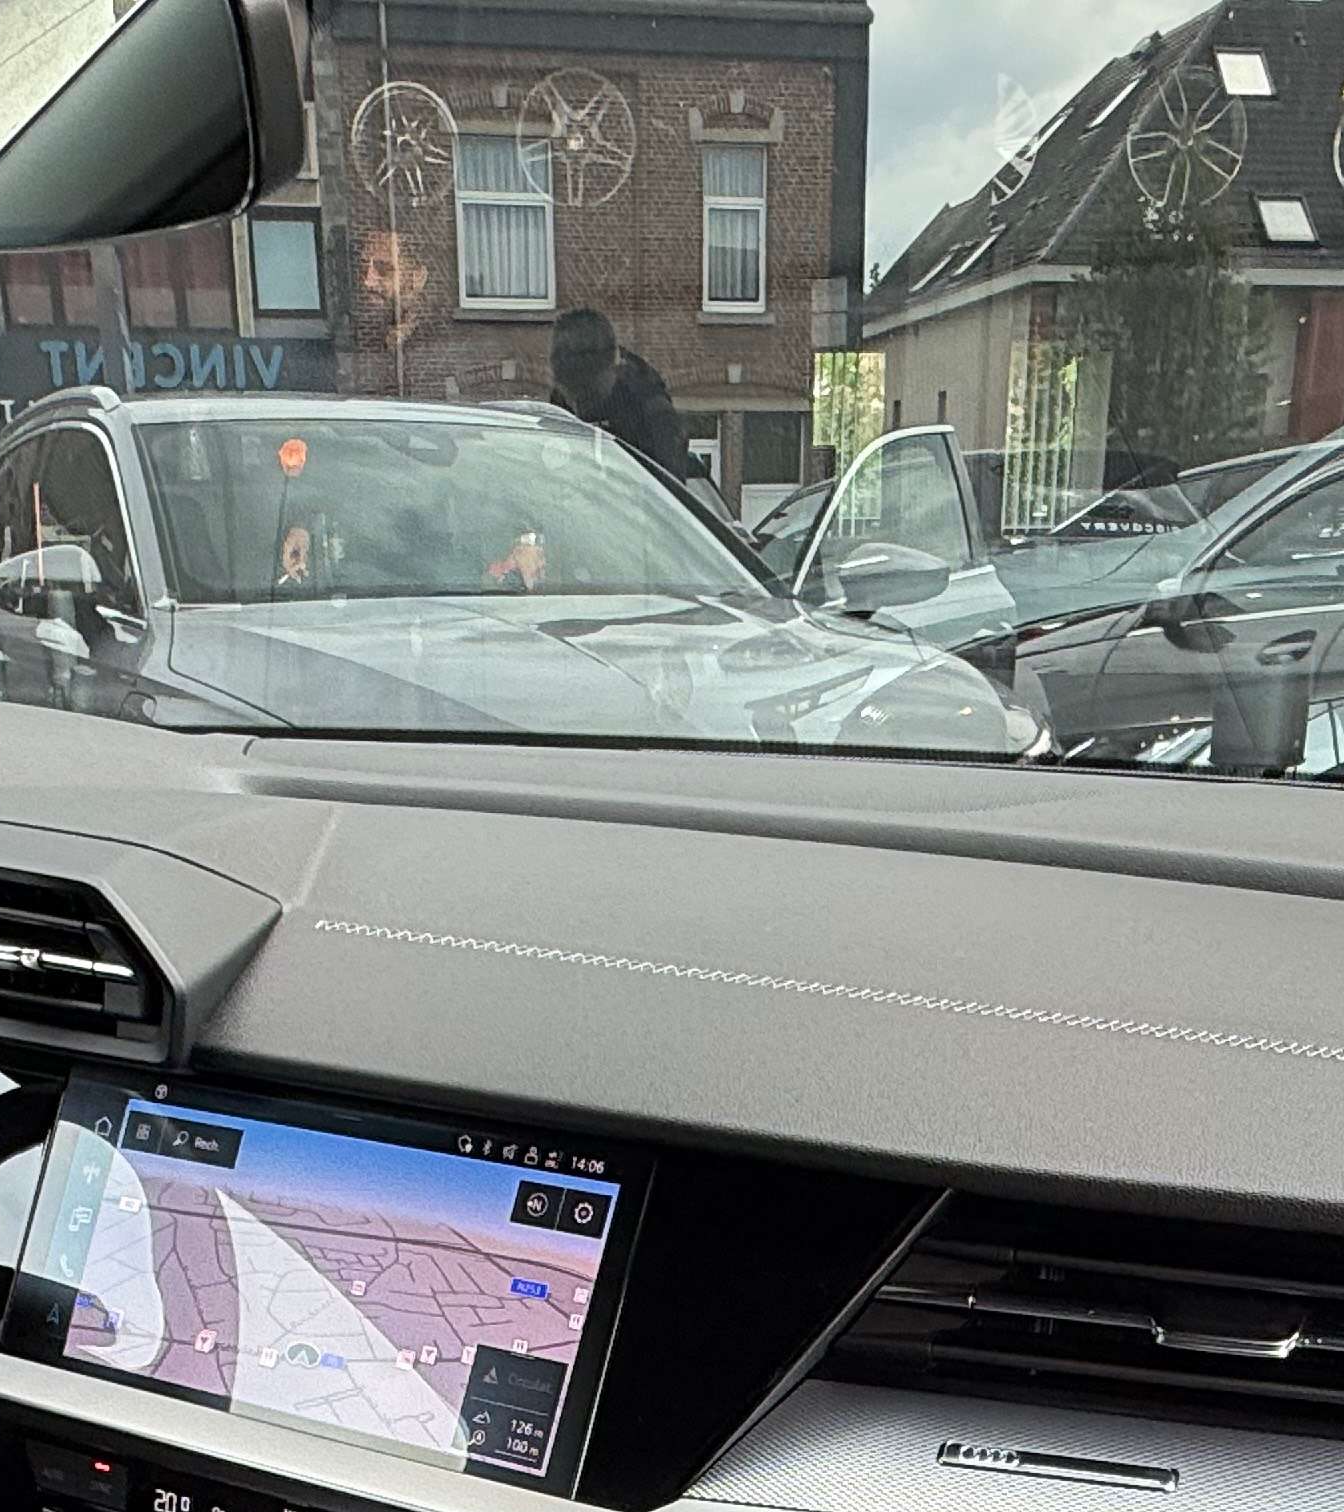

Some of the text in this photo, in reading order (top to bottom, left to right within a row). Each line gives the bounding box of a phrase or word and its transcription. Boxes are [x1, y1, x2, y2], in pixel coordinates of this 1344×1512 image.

[572, 1156, 605, 1174] 14:06
[510, 1418, 533, 1436] 126
[506, 1436, 528, 1453] 100
